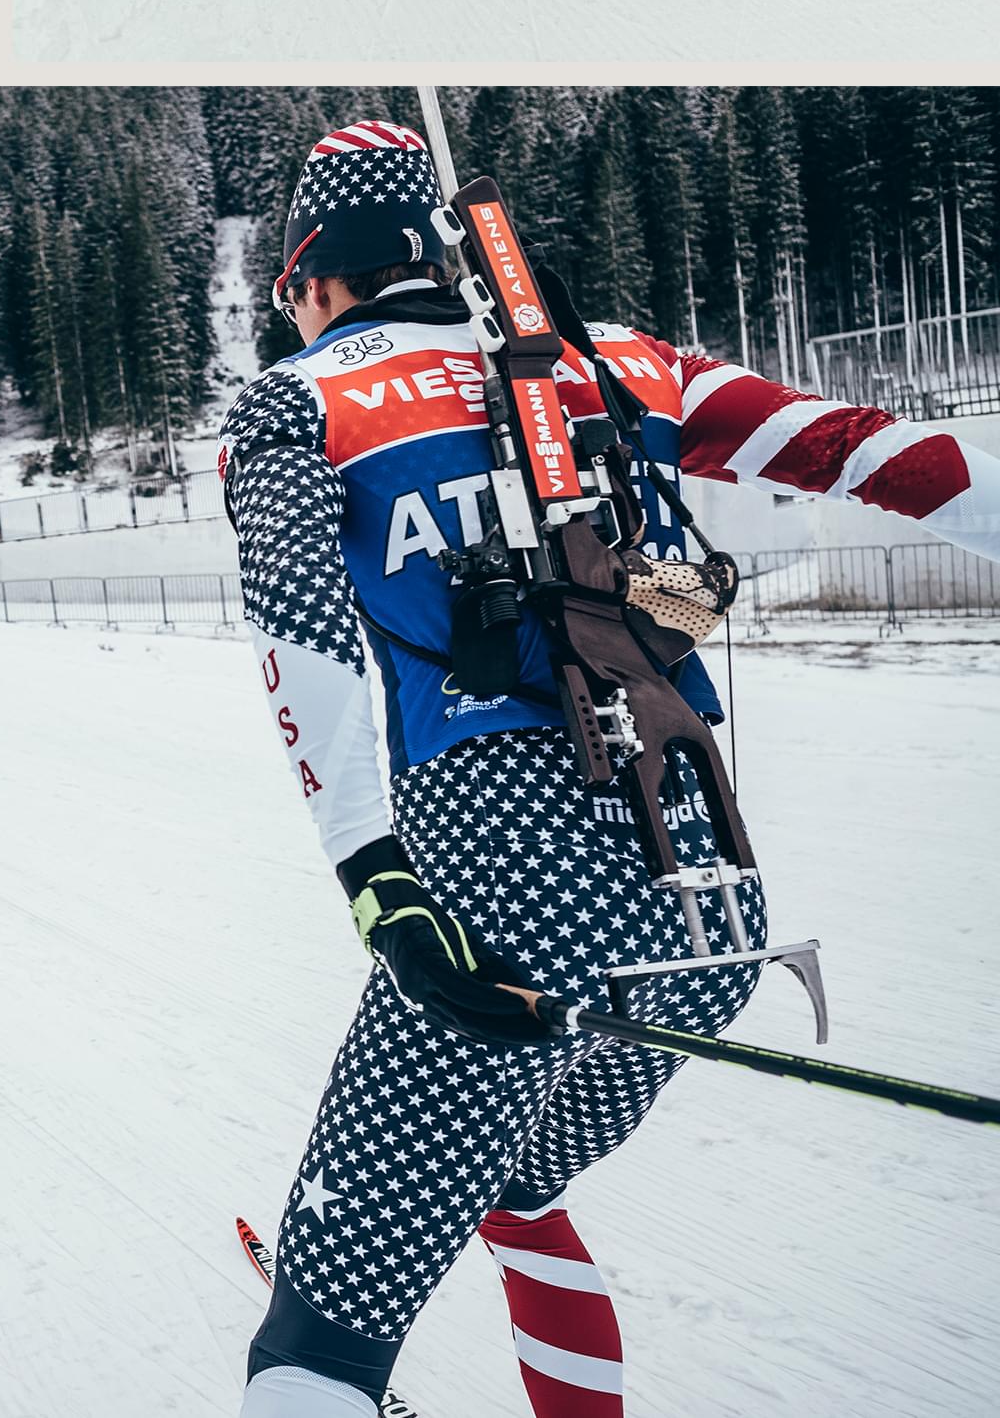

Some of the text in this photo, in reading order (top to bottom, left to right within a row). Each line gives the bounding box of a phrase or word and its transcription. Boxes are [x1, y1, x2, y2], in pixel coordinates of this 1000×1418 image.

[480, 206, 527, 297] ARIENS
[332, 330, 394, 366] 35
[526, 381, 565, 494] VIESSMANN
[262, 648, 323, 799] USA
[461, 694, 509, 707] WORLD CUP
